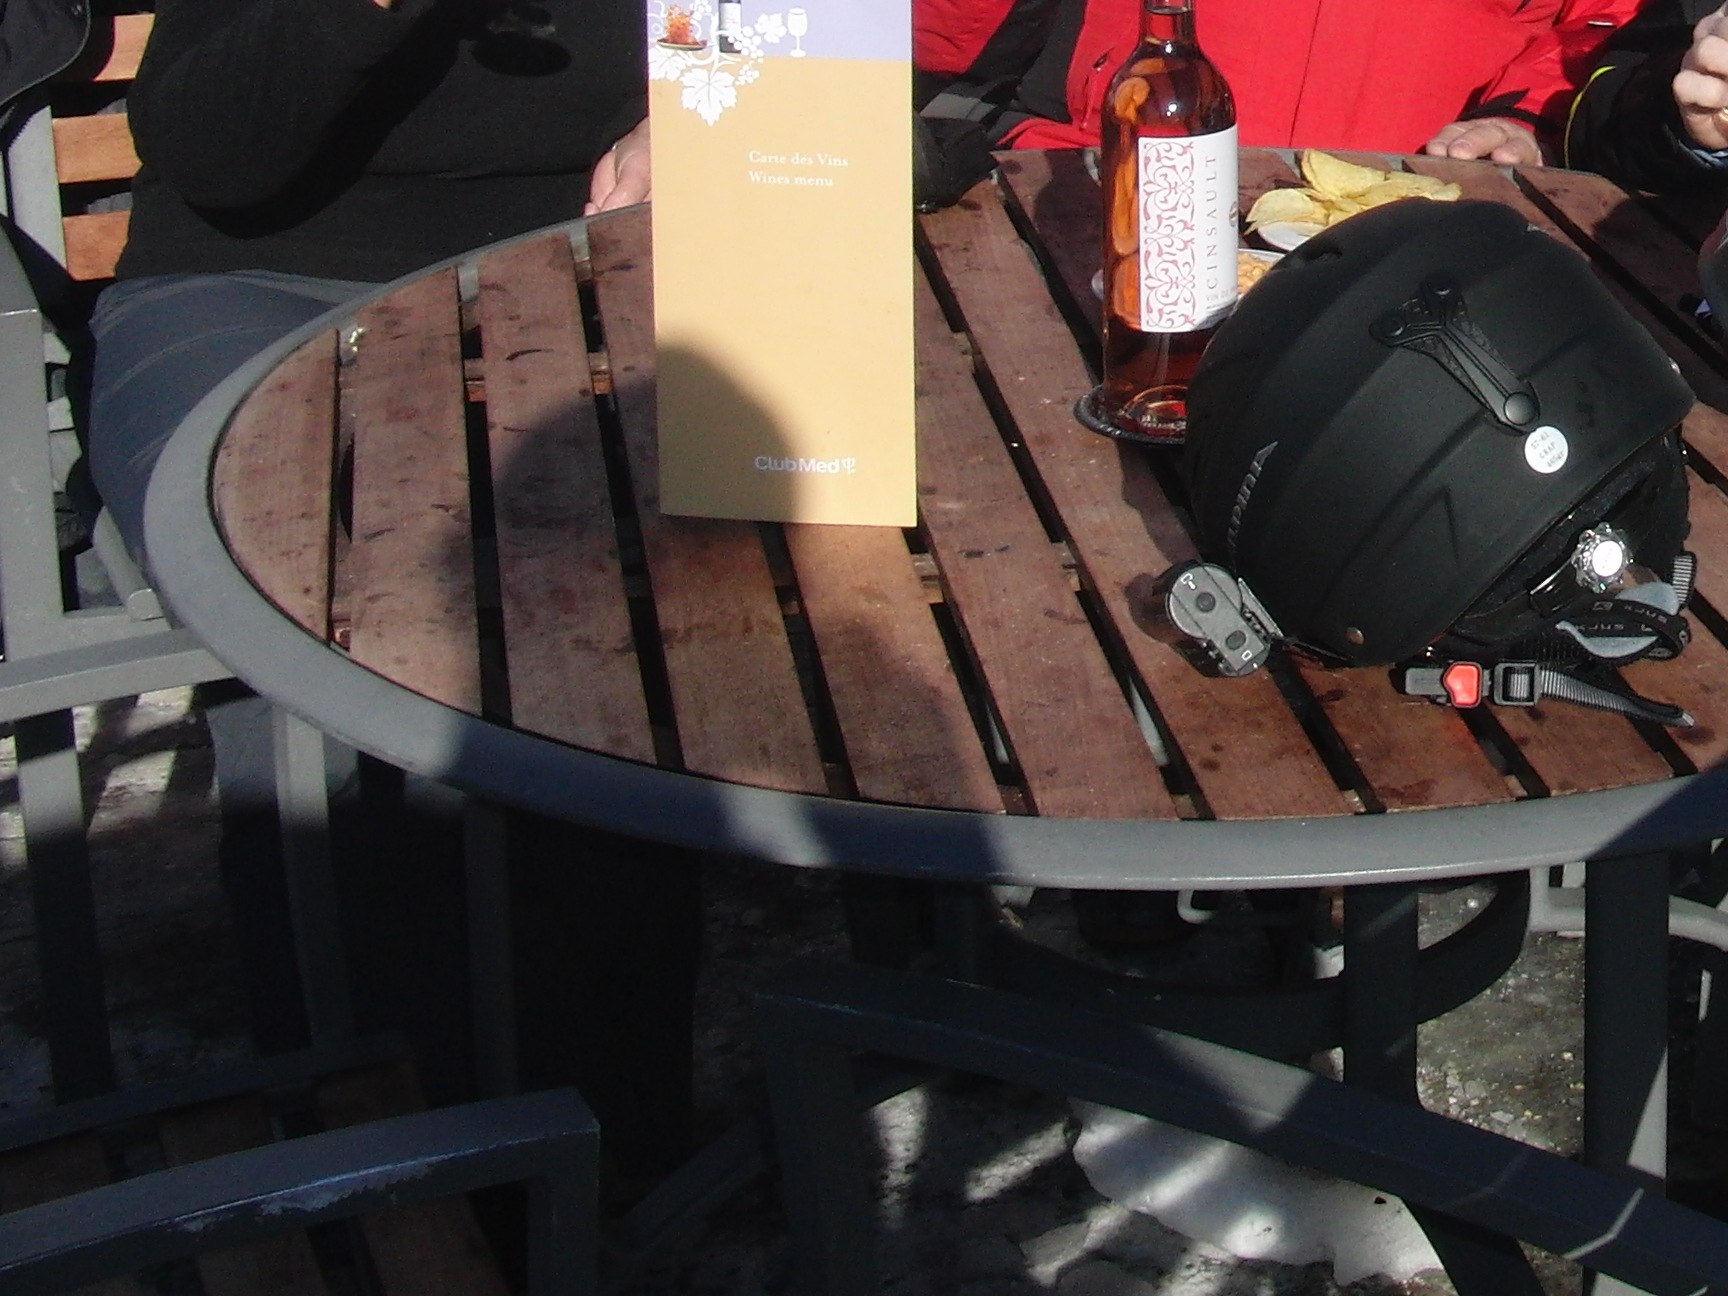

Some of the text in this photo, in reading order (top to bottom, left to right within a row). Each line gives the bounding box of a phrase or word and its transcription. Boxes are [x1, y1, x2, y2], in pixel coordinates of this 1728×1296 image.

[749, 150, 848, 167] Carte des Vins
[748, 170, 834, 187] Wines menu
[1205, 155, 1218, 290] CINSAULT
